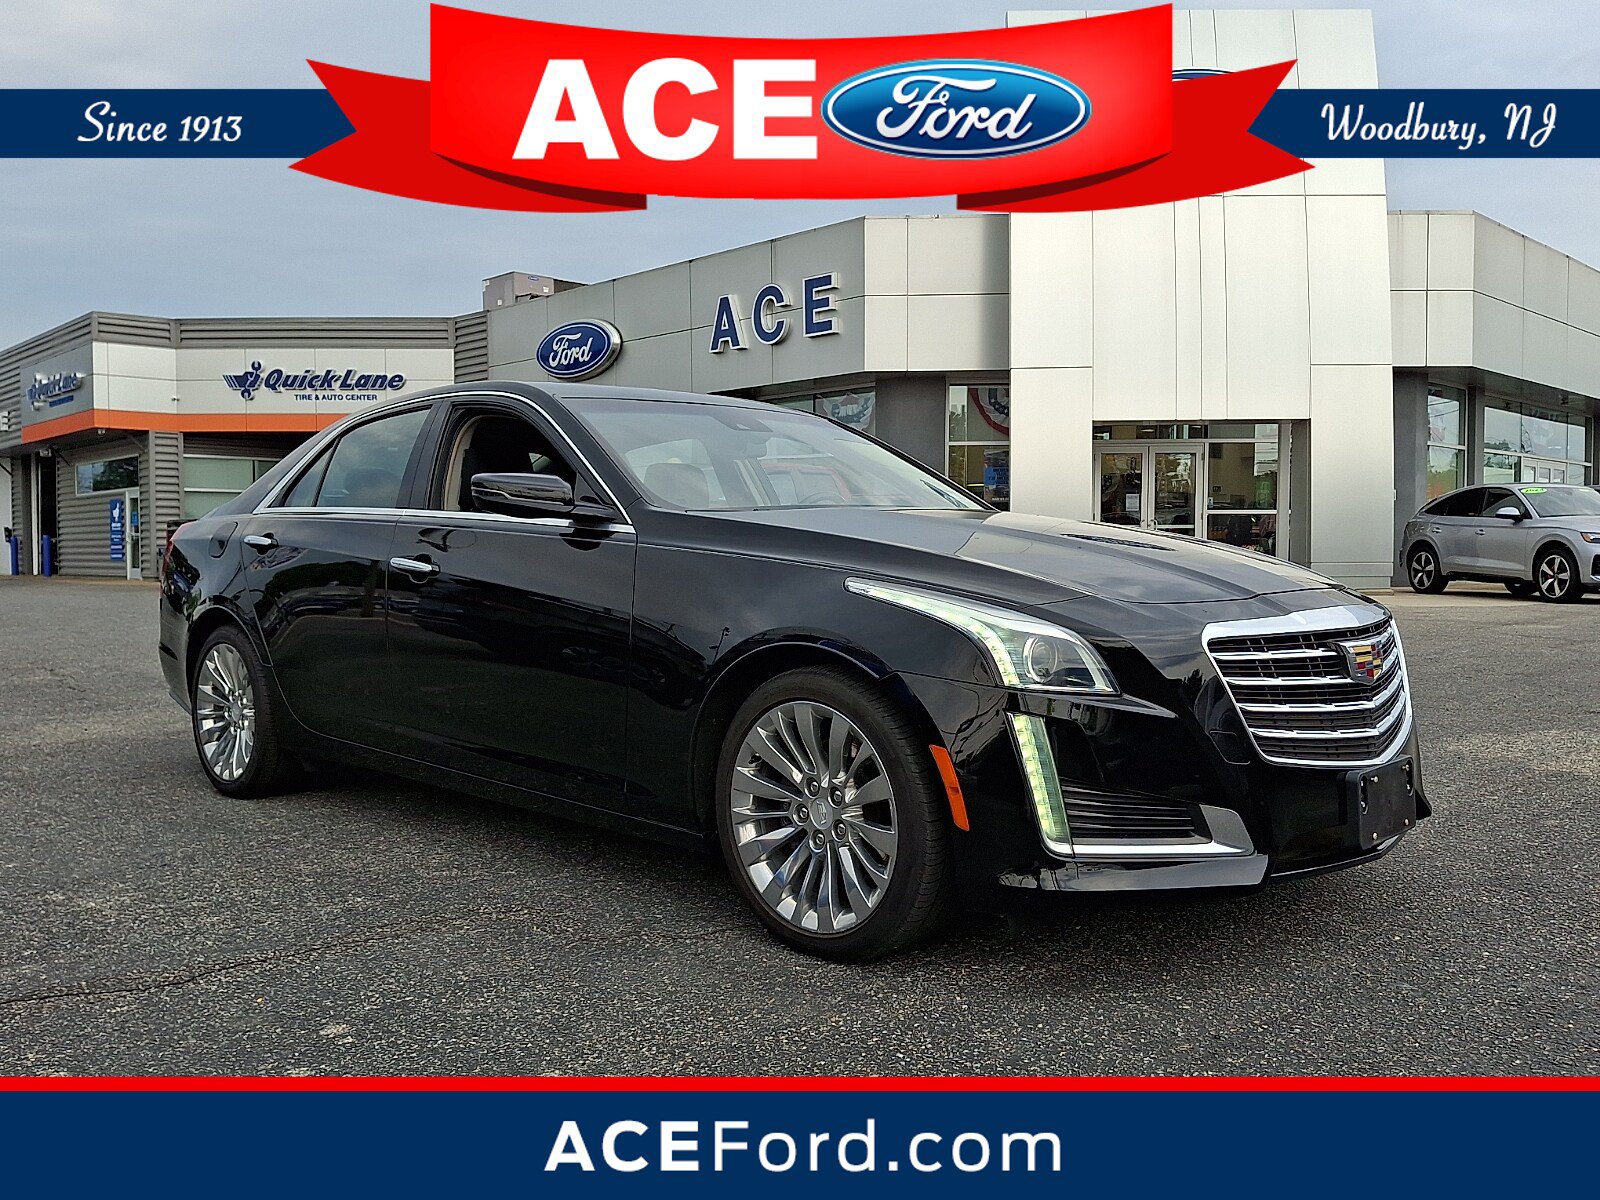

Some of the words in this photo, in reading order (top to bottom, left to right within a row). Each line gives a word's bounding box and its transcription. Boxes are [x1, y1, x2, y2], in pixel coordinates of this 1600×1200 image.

[709, 272, 839, 353] ACE
[548, 333, 594, 367] Ford
[264, 368, 339, 392] Quick
[340, 369, 406, 391] Lane
[294, 393, 314, 401] TIRE
[314, 393, 320, 401] &
[321, 393, 344, 401] AUTO
[346, 393, 378, 401] CENTER
